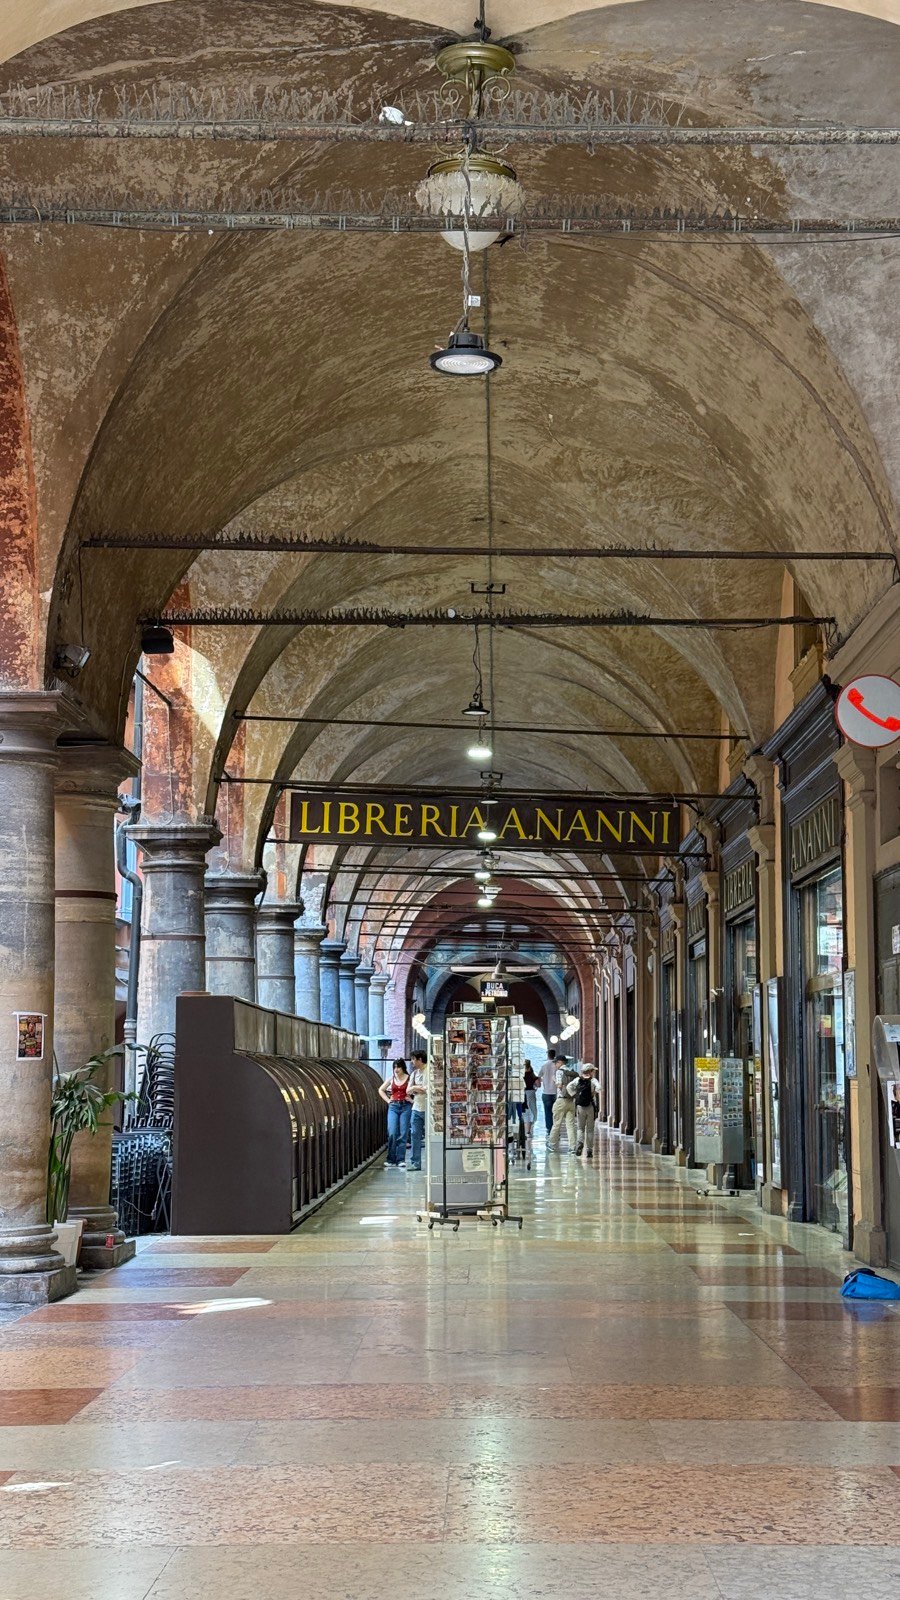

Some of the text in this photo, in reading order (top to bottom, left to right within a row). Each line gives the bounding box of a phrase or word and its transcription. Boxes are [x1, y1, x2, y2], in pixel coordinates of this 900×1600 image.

[299, 801, 671, 845] LIBRERIA A.NANNI
[791, 798, 836, 871] A.NANNI
[723, 859, 753, 913] LIBRERIA
